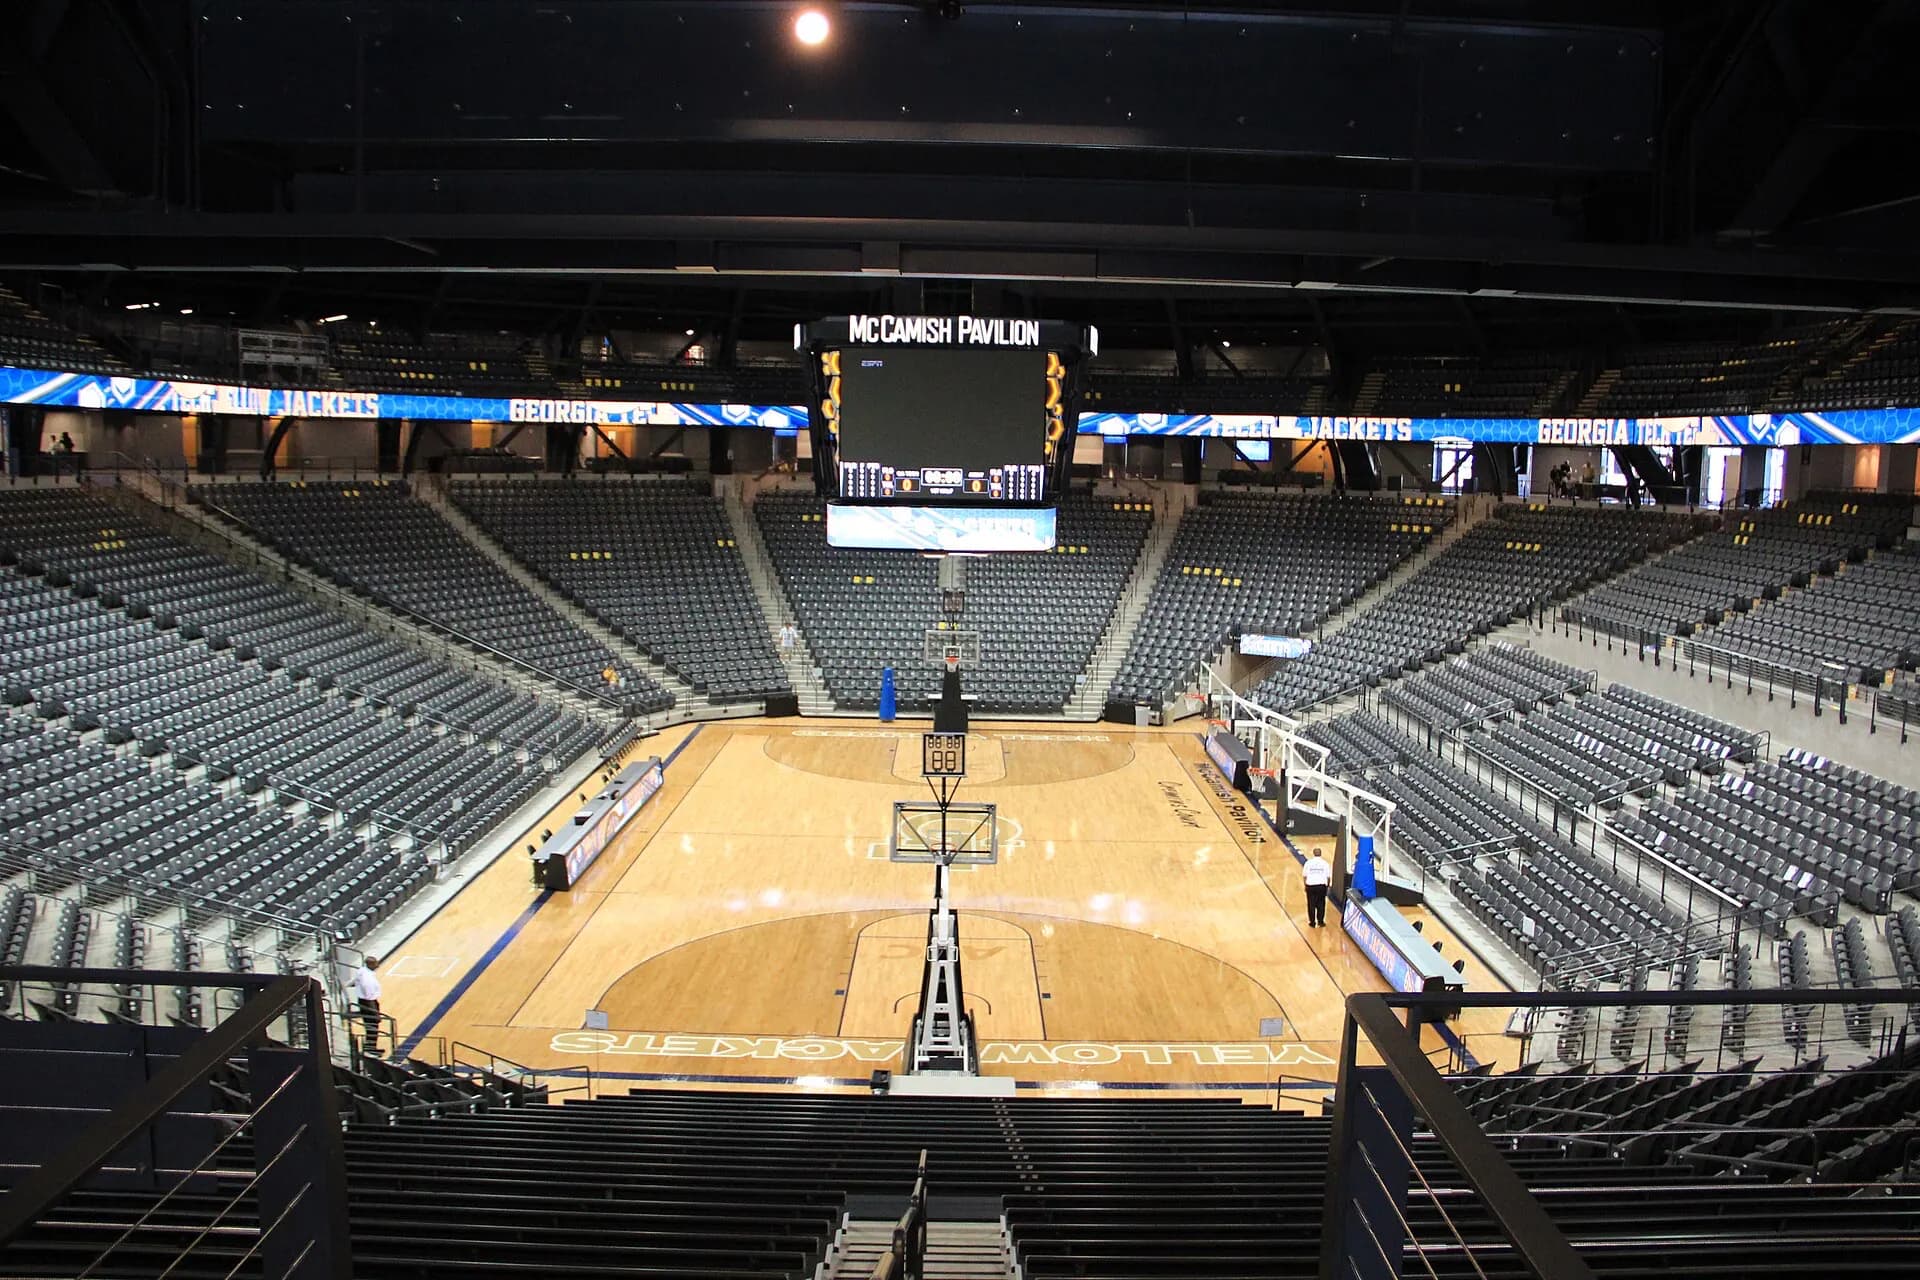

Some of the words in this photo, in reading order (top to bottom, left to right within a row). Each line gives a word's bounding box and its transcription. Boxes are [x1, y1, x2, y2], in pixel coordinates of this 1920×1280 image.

[958, 315, 1039, 346] PAVILION
[277, 389, 379, 418] JACKETS
[1305, 416, 1412, 441] JACKETS
[1538, 418, 1630, 445] GEORGIA
[1229, 805, 1267, 843] Pavilion
[550, 1031, 905, 1062] ACKETS
[979, 1042, 1337, 1065] YELLOW
